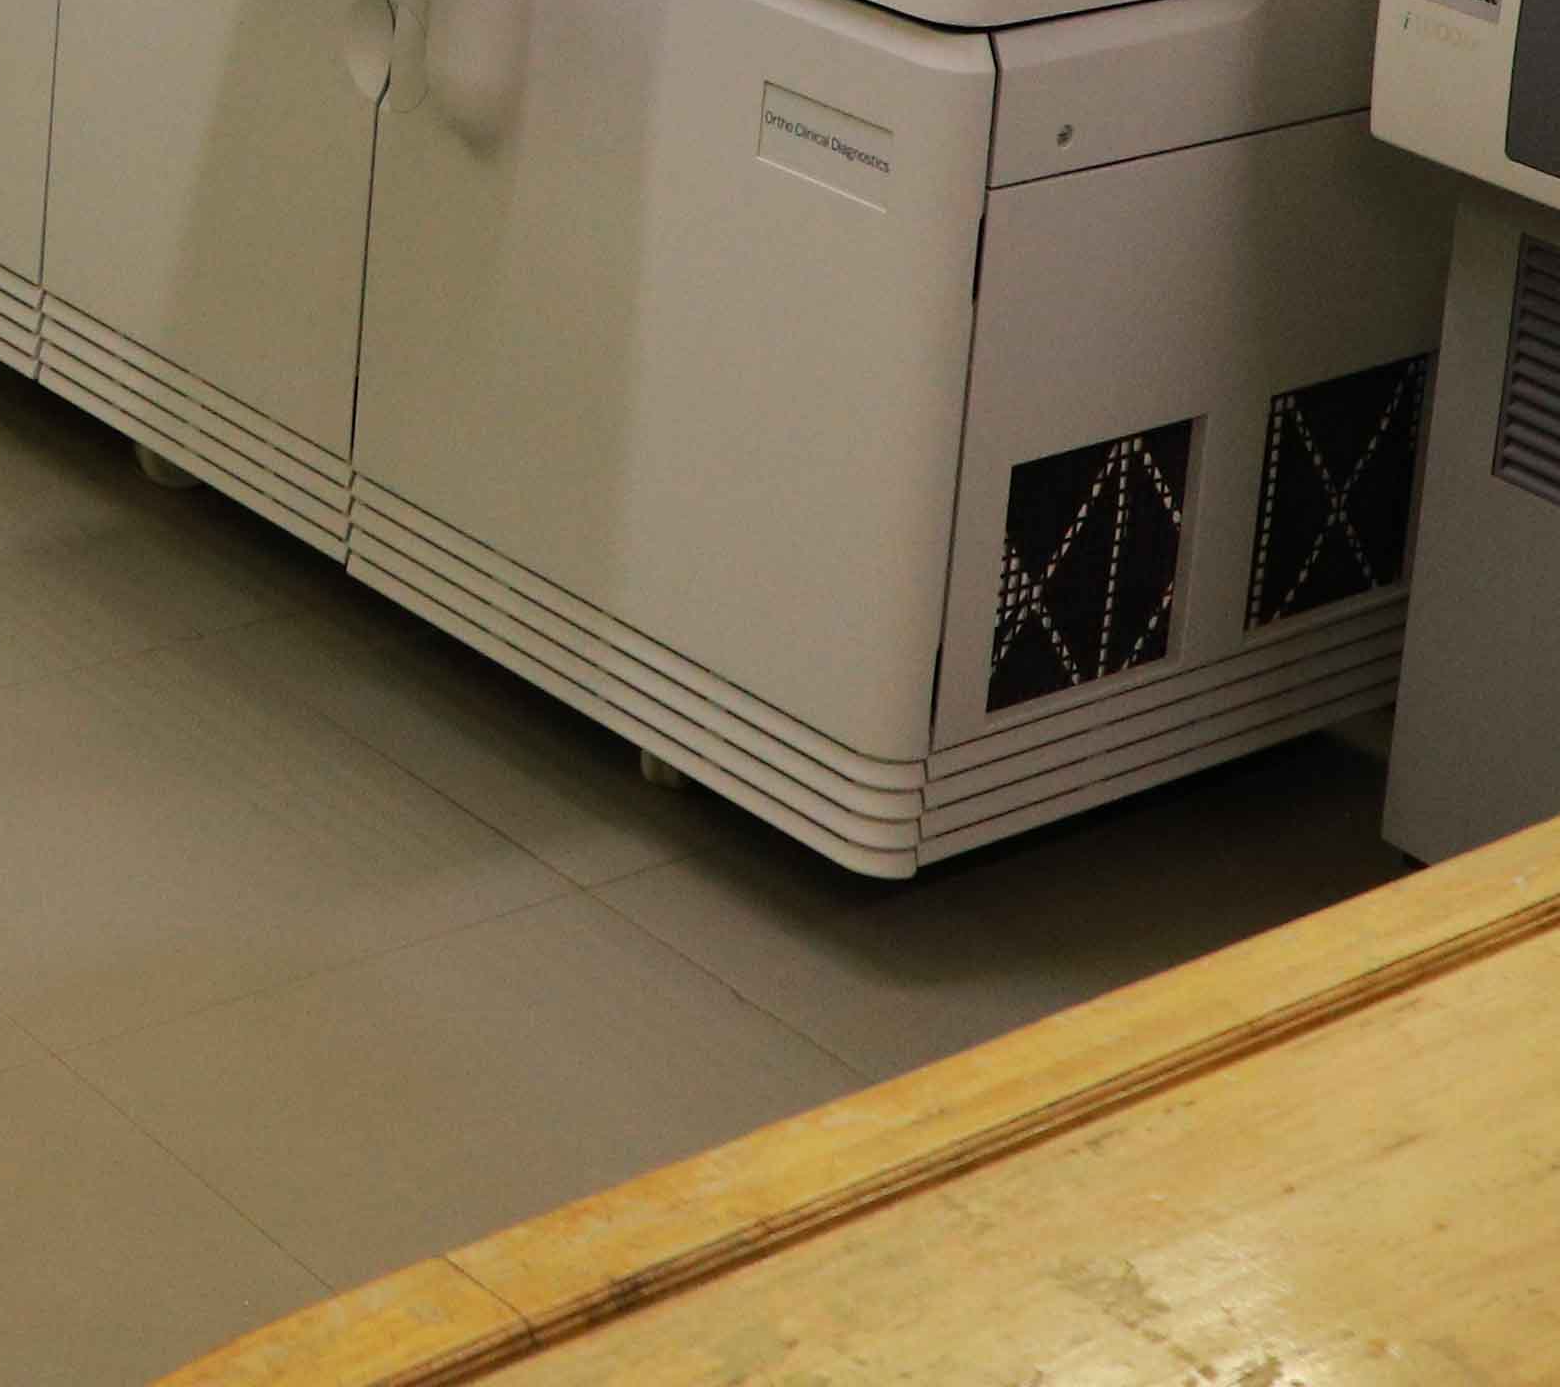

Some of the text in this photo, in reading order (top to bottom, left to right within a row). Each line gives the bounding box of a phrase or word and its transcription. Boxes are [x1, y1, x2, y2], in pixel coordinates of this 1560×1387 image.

[765, 110, 890, 173] Ortho Clinical Diagnostics
